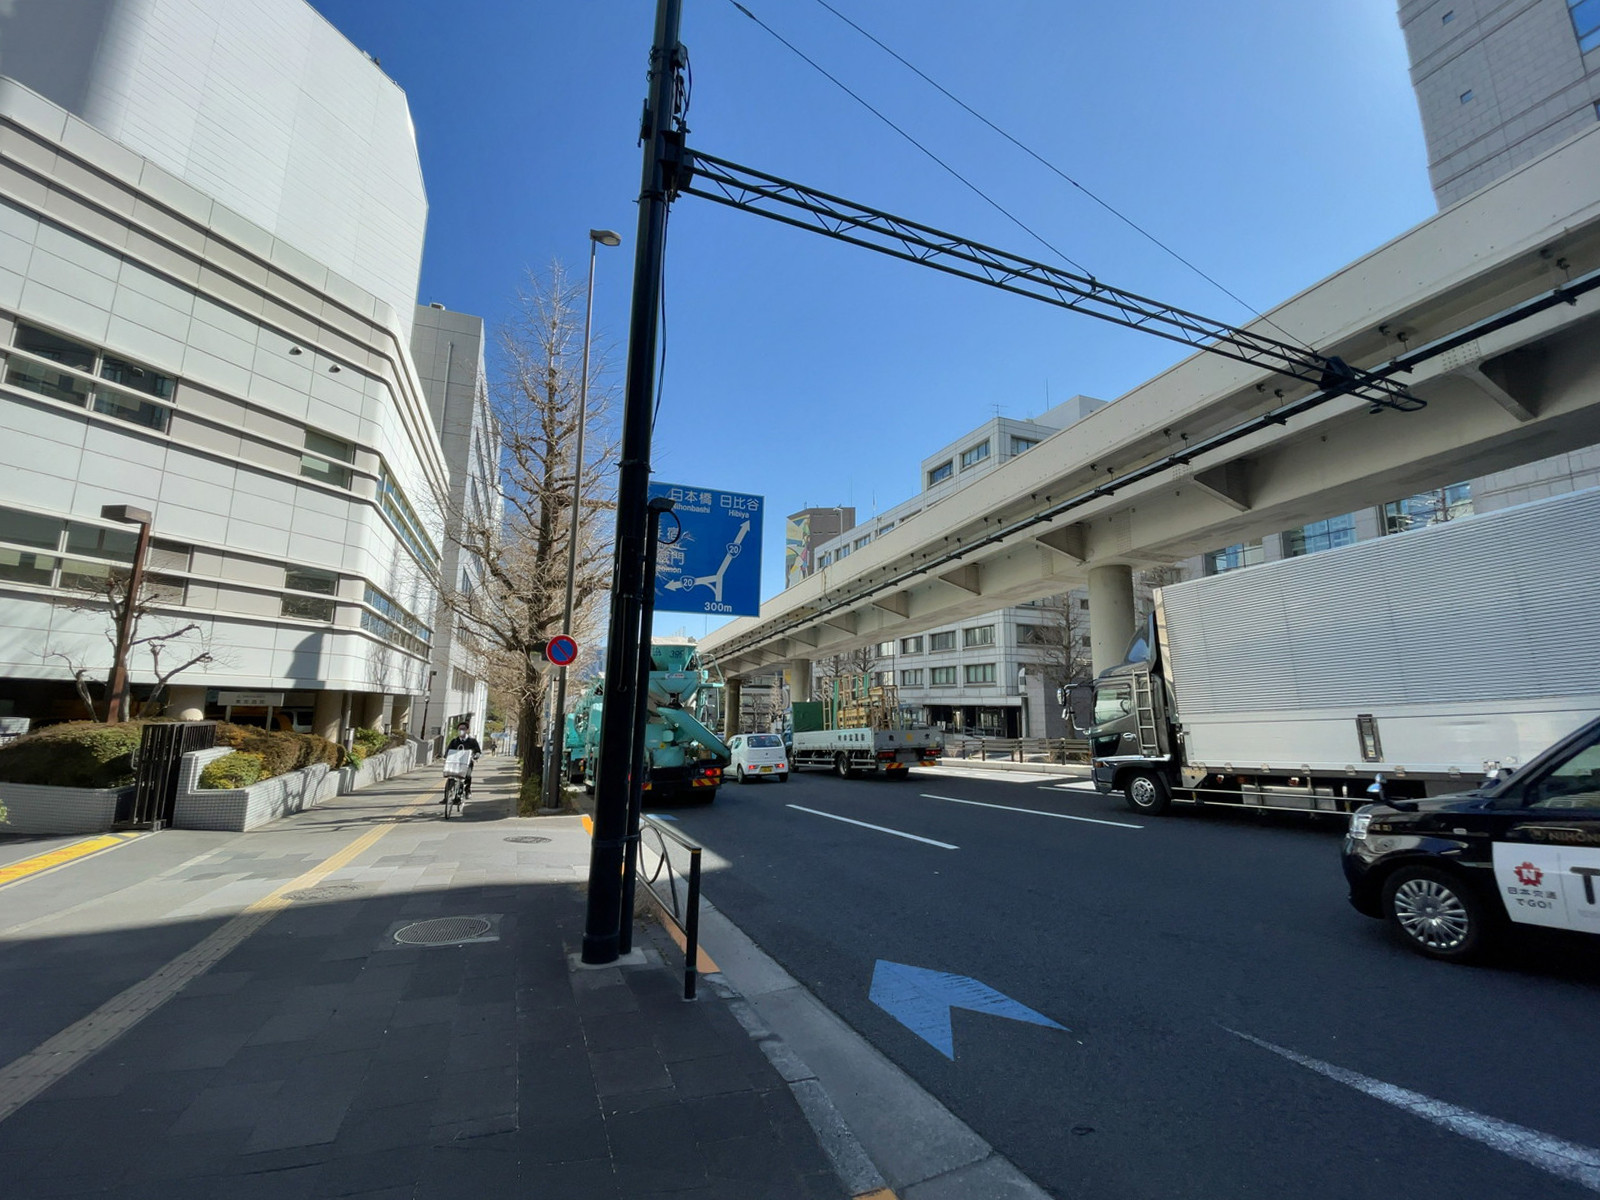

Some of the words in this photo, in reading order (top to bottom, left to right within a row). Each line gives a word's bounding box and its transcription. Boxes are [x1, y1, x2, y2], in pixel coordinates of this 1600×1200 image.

[670, 488, 712, 506] 日本橋
[720, 494, 760, 512] 日比谷
[728, 509, 750, 519] Hibiya
[729, 545, 739, 554] 20
[683, 578, 693, 587] 20
[704, 602, 733, 612] 300m
